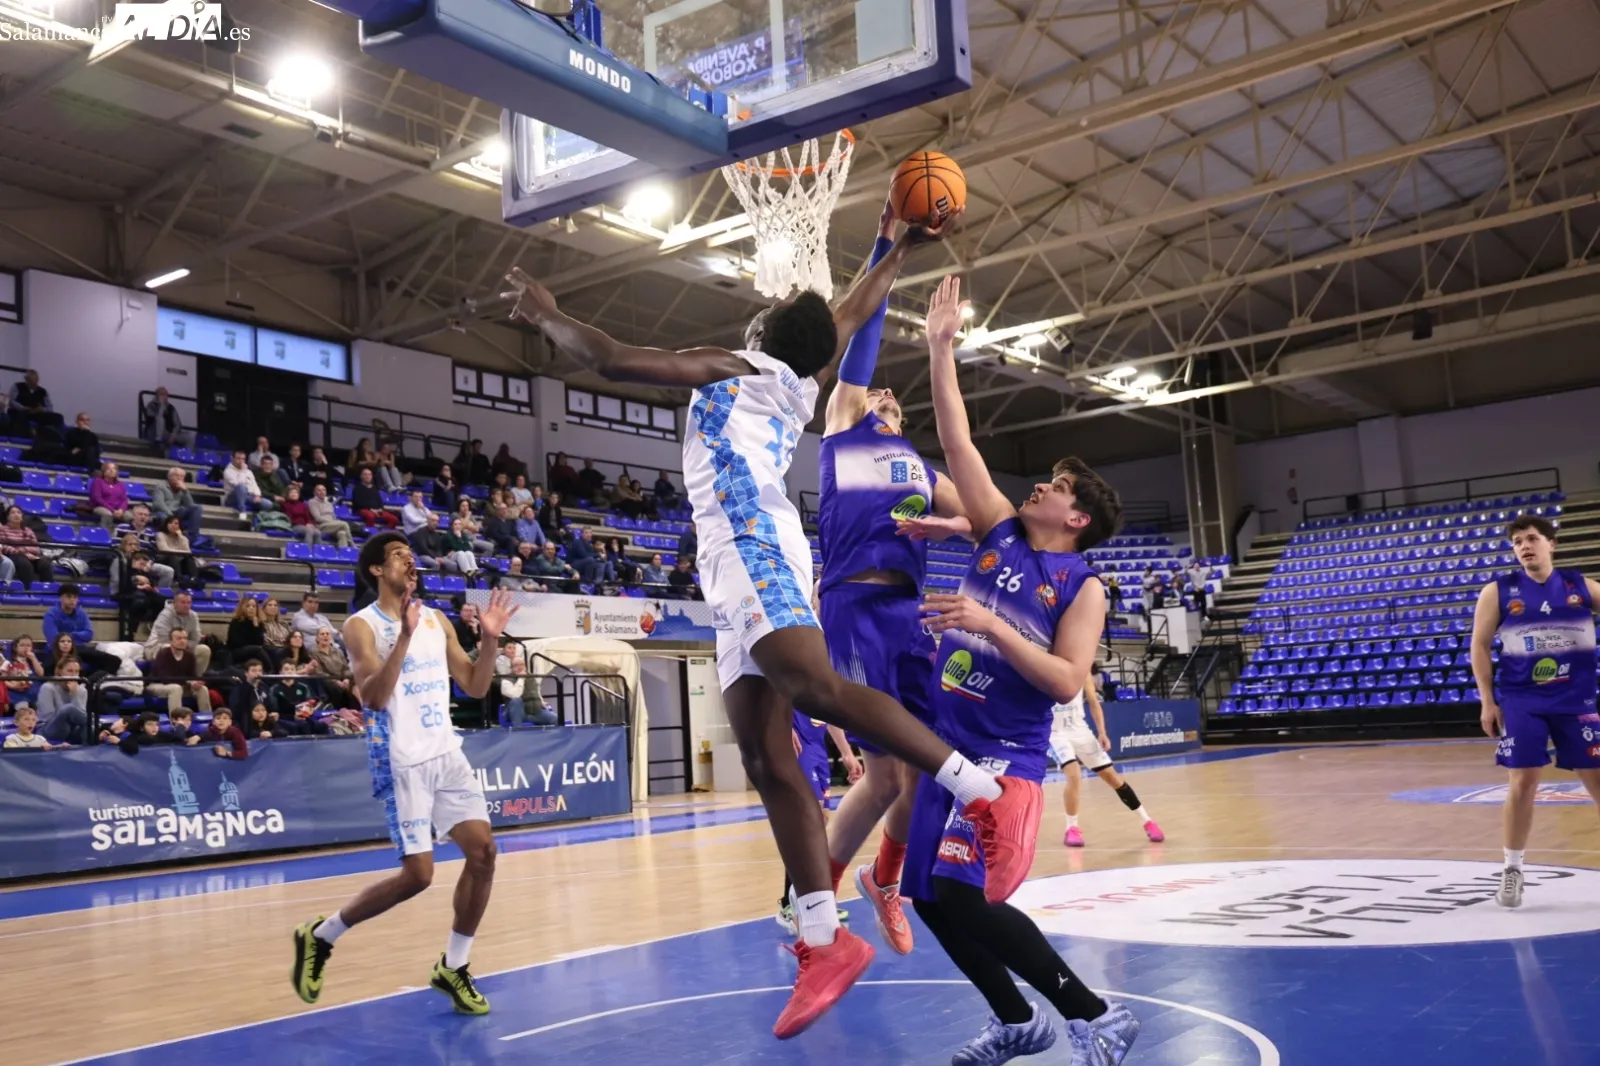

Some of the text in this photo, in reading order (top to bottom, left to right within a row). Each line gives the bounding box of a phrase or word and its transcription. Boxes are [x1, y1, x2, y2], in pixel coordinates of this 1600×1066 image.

[569, 48, 631, 93] MONDO
[996, 566, 1024, 593] 26
[594, 612, 638, 623] Ayuntamiento
[1540, 600, 1552, 615] 4
[594, 624, 638, 634] de Salamanca
[944, 659, 994, 691] Ulla Oil
[1533, 663, 1570, 678] Ulla Oil
[420, 702, 444, 728] 26
[537, 763, 553, 792] Y
[562, 753, 615, 786] LEÓN
[89, 804, 155, 821] turismo
[502, 795, 567, 819] IMPULSA
[939, 840, 972, 861] ABRIL
